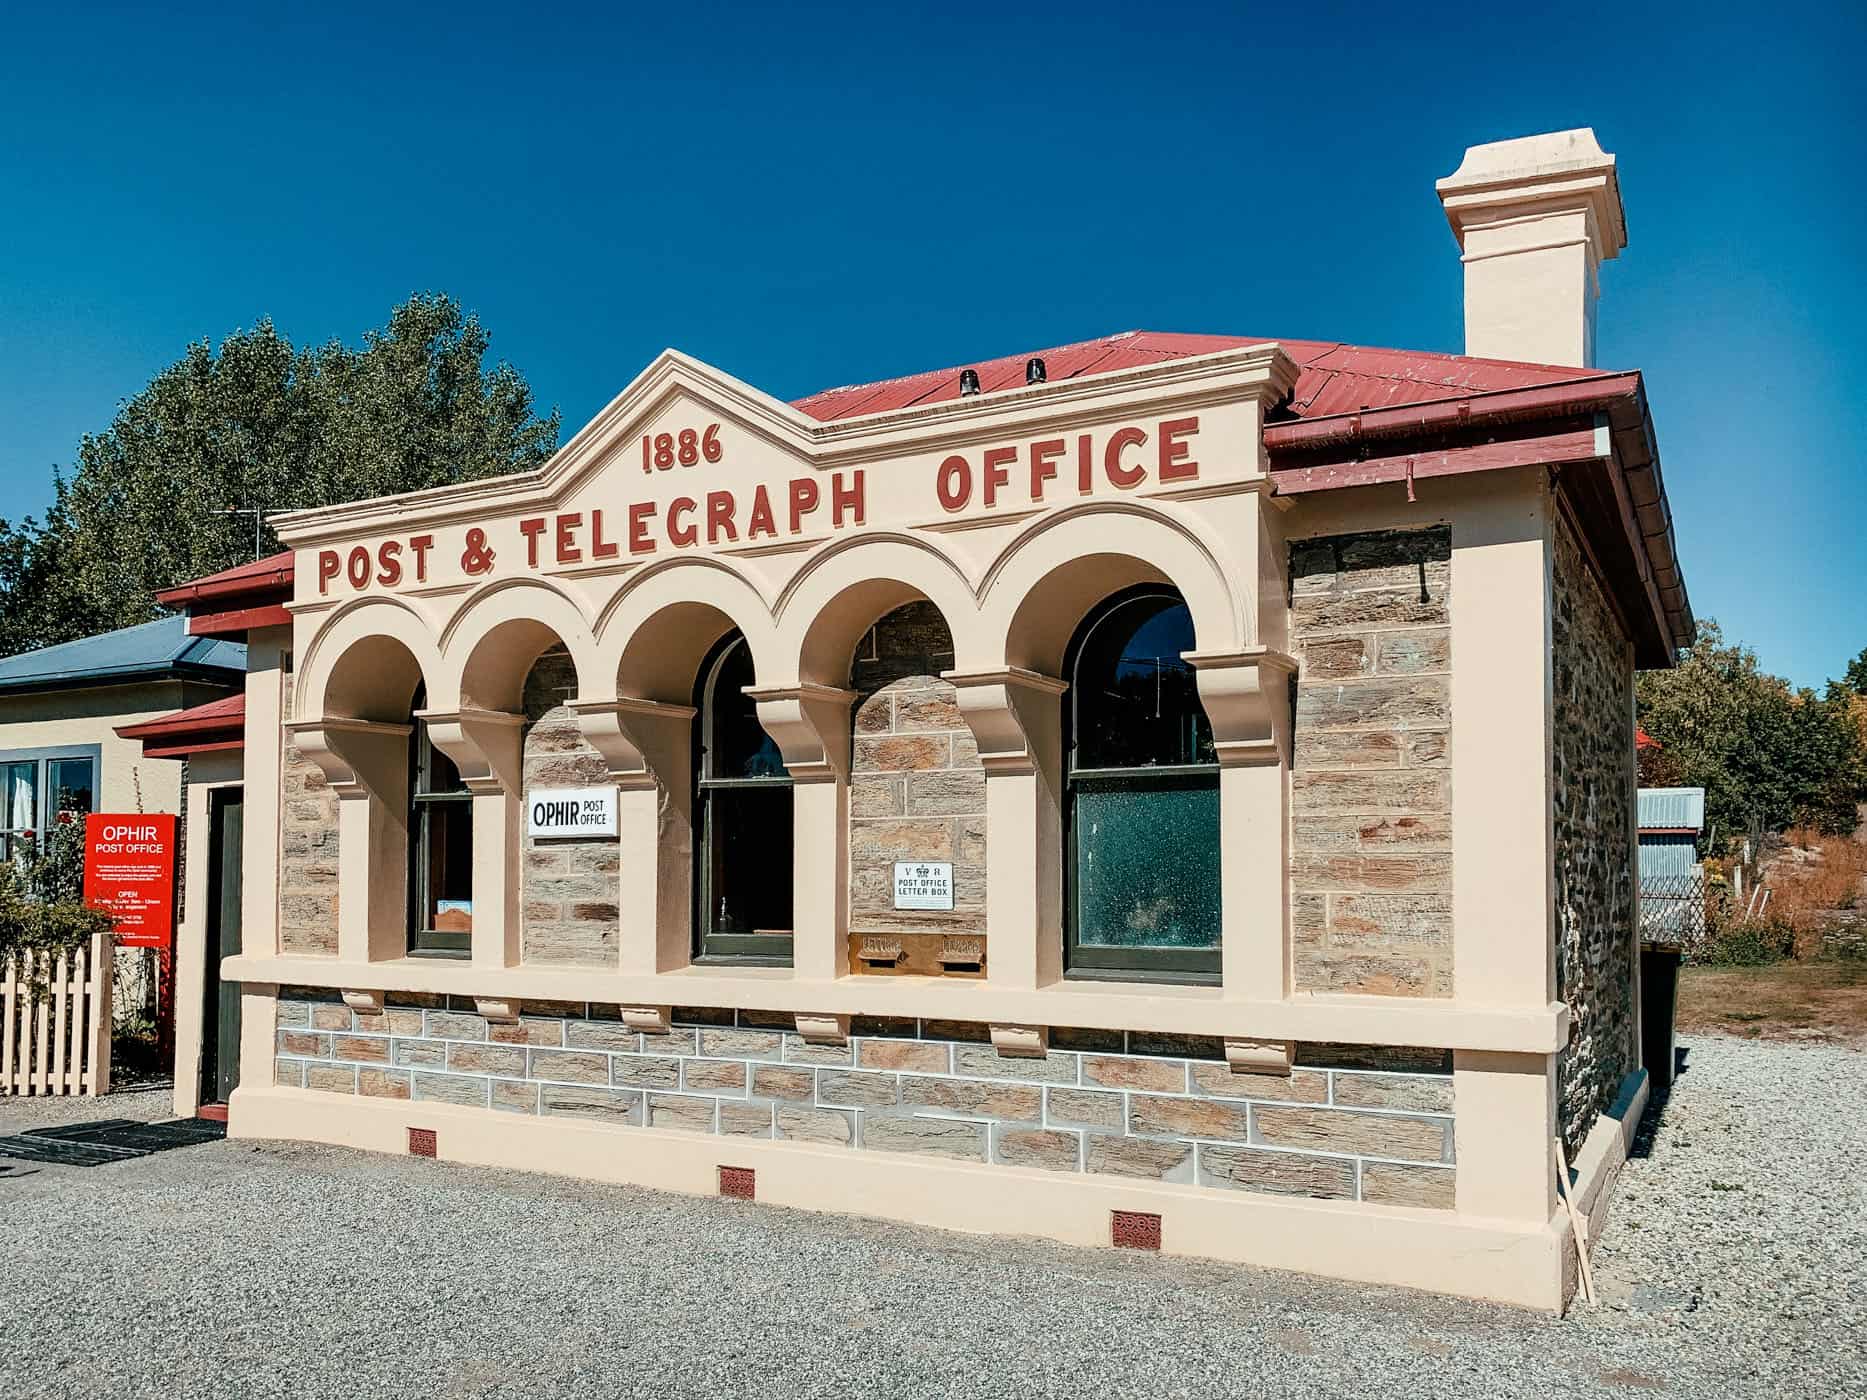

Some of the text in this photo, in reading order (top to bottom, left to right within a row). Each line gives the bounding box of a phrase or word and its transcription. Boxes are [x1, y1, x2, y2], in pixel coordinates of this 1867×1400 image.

[642, 423, 724, 474] 1886
[318, 415, 1200, 595] POST & TELEGRAPH OFFICE
[583, 799, 605, 812] POST
[533, 801, 580, 827] OPHIR
[580, 813, 607, 825] OFFICE
[102, 825, 158, 841] OPHIR
[95, 843, 164, 854] POST OFFICE
[904, 867, 912, 876] V
[898, 879, 948, 887] POST OFFICE
[898, 887, 949, 896] LETTER BOX
